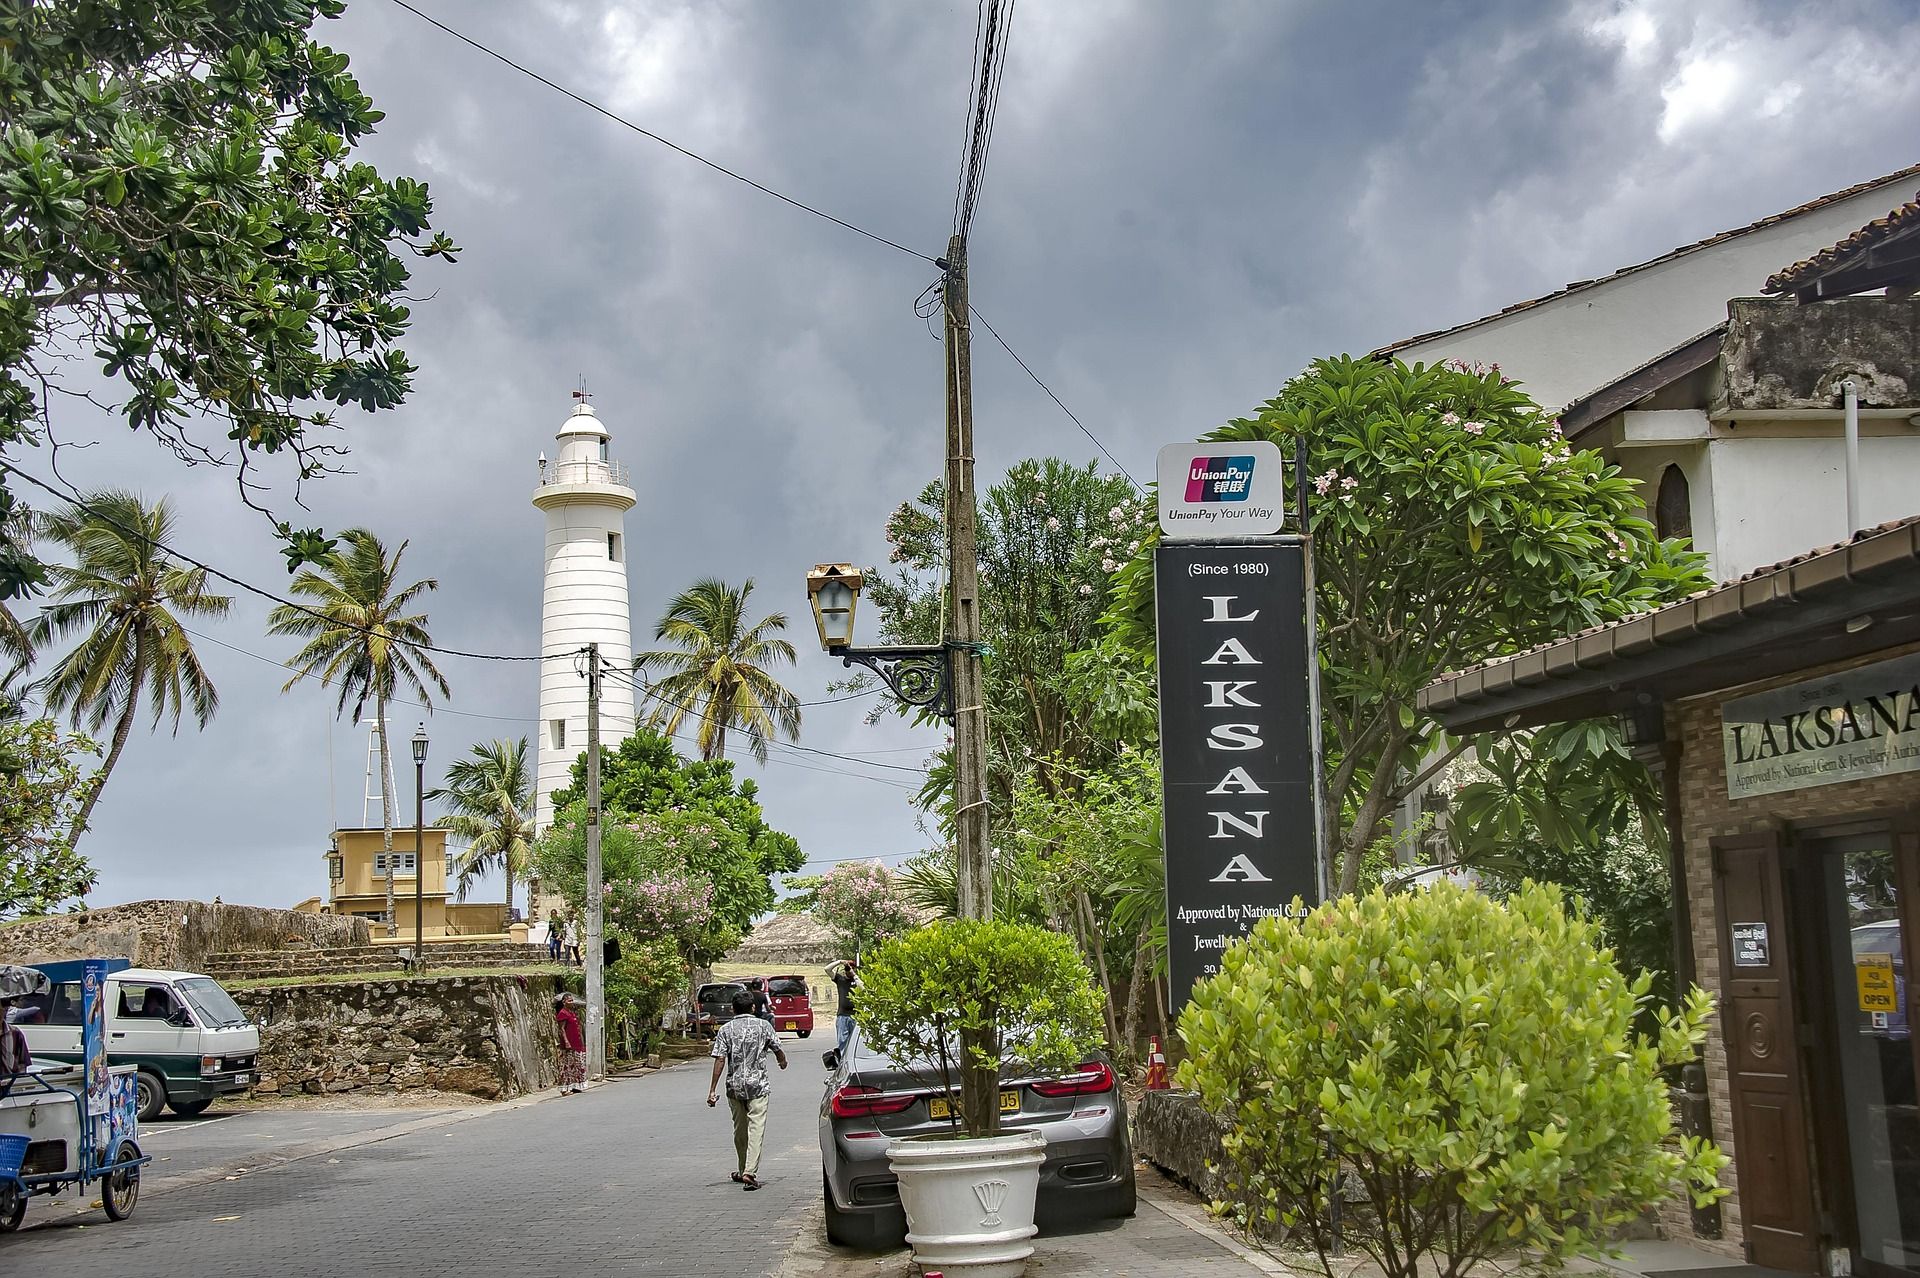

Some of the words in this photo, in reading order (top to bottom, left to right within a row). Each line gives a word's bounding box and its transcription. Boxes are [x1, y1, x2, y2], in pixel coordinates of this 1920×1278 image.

[1191, 467, 1251, 483] UnionPay
[1213, 481, 1245, 493] 银联
[1168, 509, 1217, 523] UnionPay
[1220, 508, 1245, 519] Your
[1248, 507, 1273, 519] Way
[1188, 563, 1229, 577] (Since
[1233, 562, 1269, 576] 1980)
[1731, 684, 1920, 765] LAKSANA
[1201, 596, 1272, 882] LAKSANA
[1838, 755, 1848, 770] &
[1177, 905, 1226, 924] Approved
[1227, 905, 1241, 923] by
[1242, 904, 1283, 918] National
[1239, 922, 1247, 931] &
[1864, 994, 1891, 1005] OPEN
